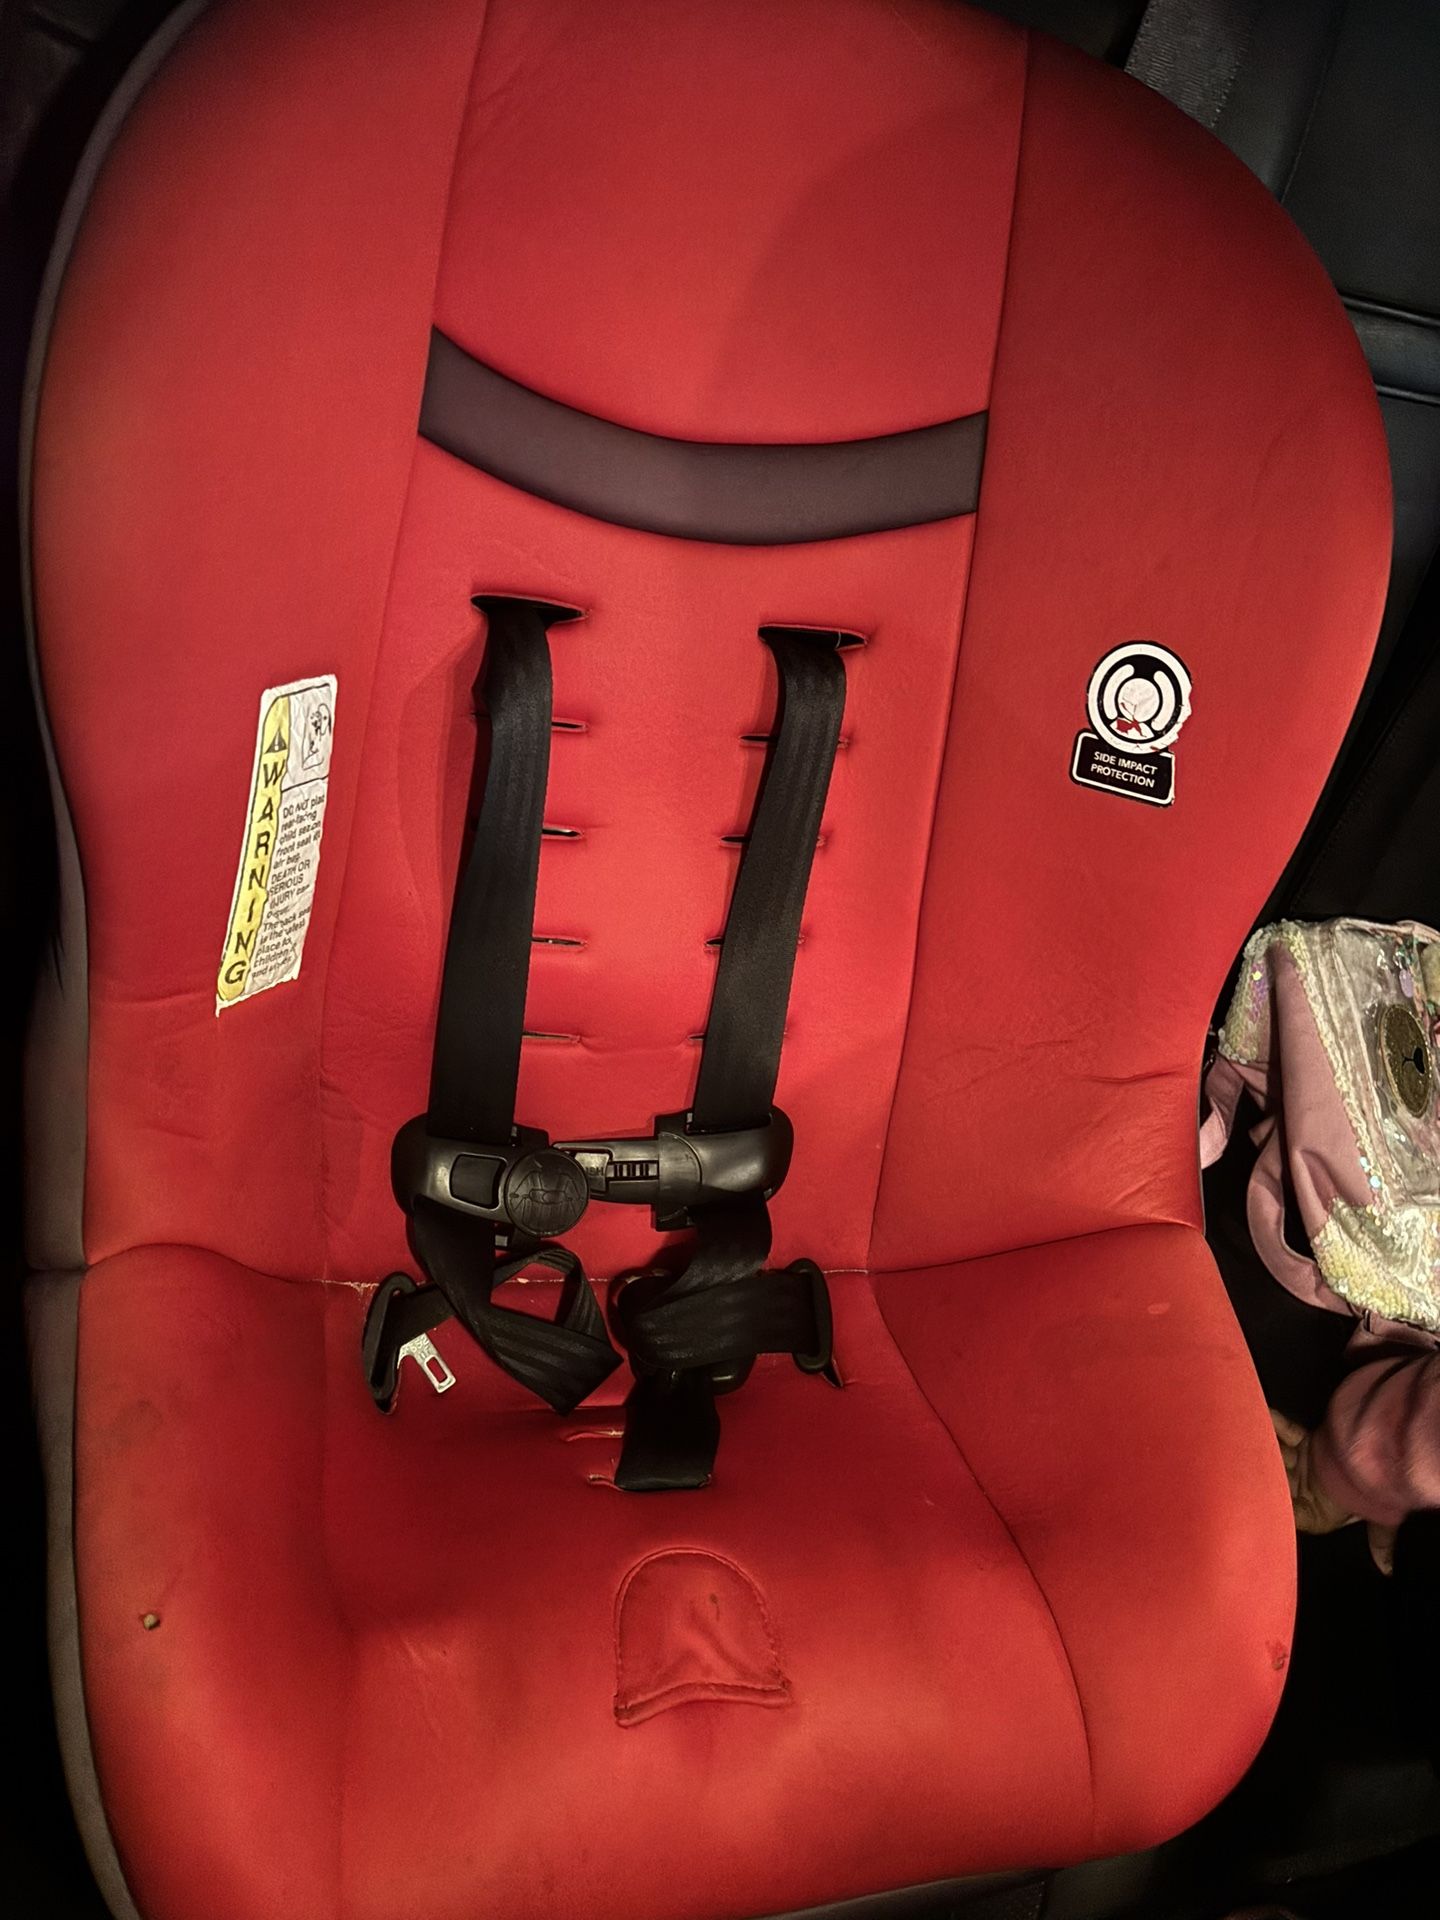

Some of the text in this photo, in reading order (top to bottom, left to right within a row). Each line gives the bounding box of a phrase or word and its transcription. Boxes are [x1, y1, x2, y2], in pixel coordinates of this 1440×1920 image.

[1094, 751, 1158, 775] SIDE IMPACT
[1090, 763, 1155, 788] PROTECTION
[295, 798, 309, 812] NOT
[225, 759, 286, 984] WARNING
[271, 859, 310, 884] DEATH OR
[270, 873, 304, 896] SERIOUS
[270, 888, 295, 909] INJURY
[256, 941, 281, 959] place
